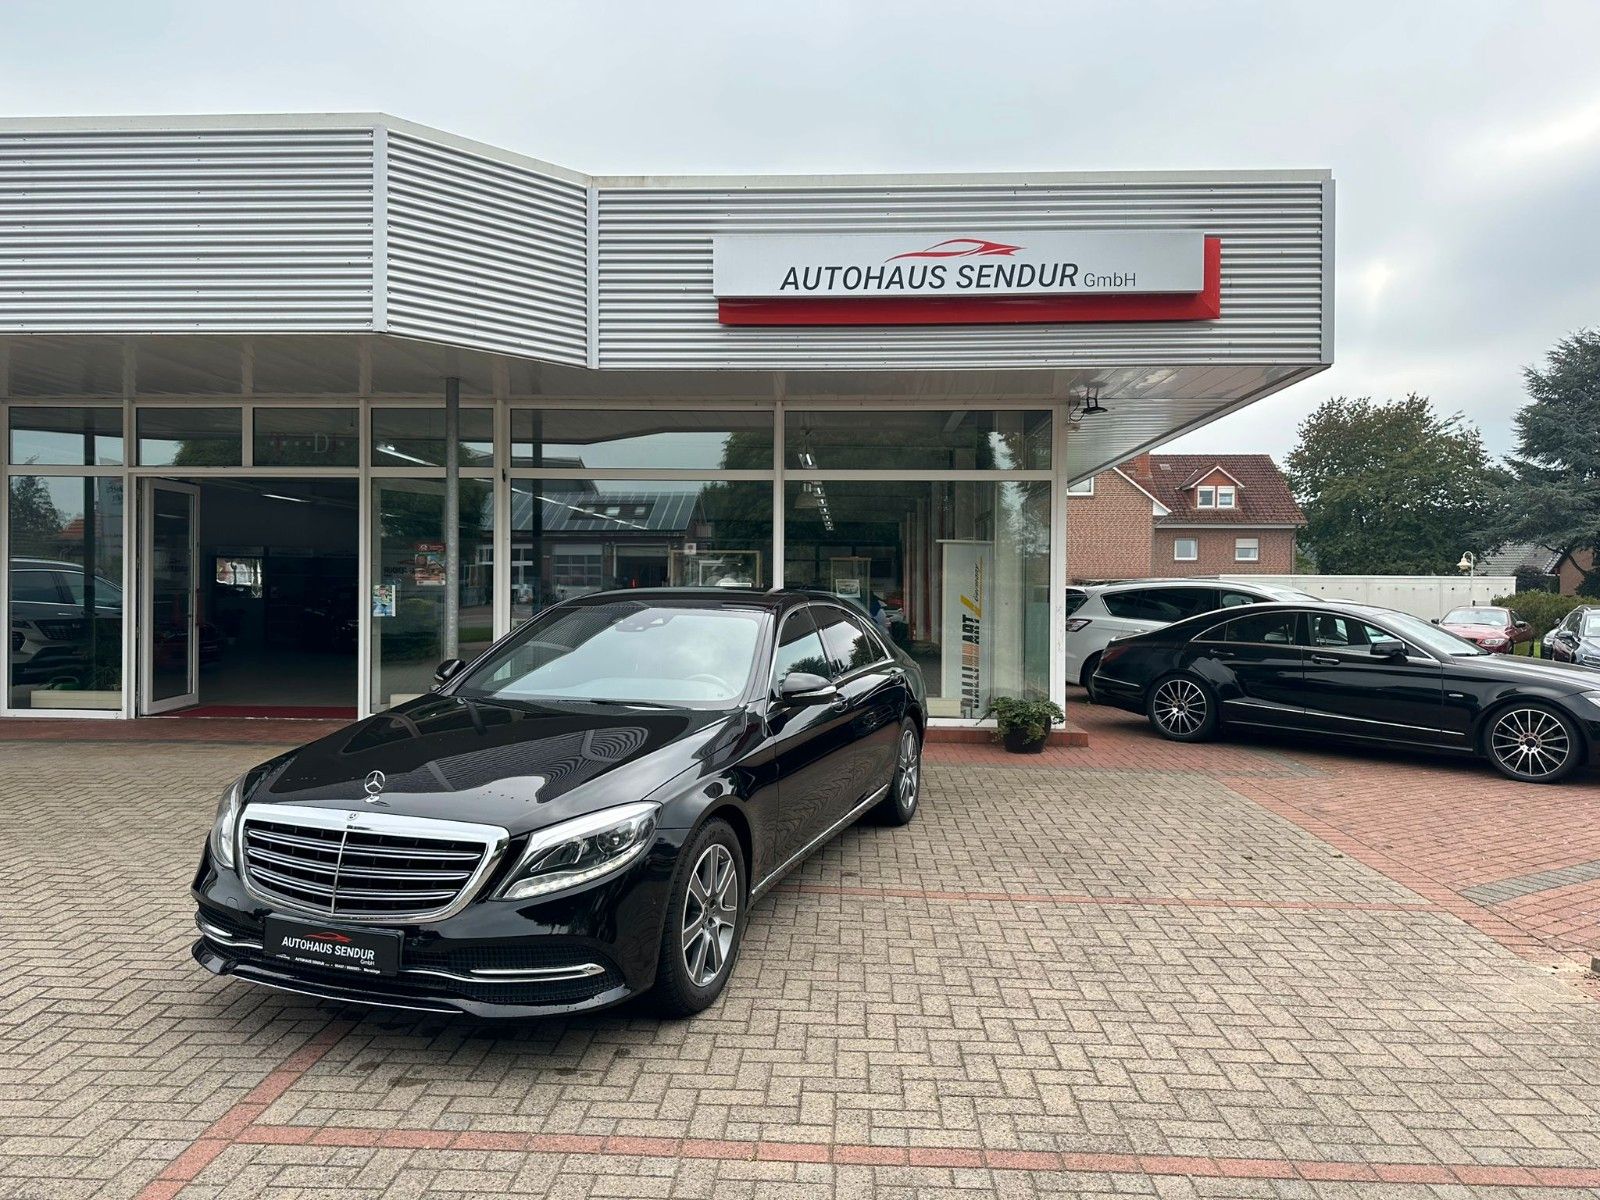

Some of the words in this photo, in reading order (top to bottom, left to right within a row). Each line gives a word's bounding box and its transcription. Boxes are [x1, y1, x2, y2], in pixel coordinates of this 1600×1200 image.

[780, 264, 947, 291] AUTOHAUS
[956, 263, 1079, 289] SENDUR
[1084, 271, 1136, 288] GmbH
[281, 936, 333, 954] AUTOHAUS
[335, 945, 375, 960] SENDUR
